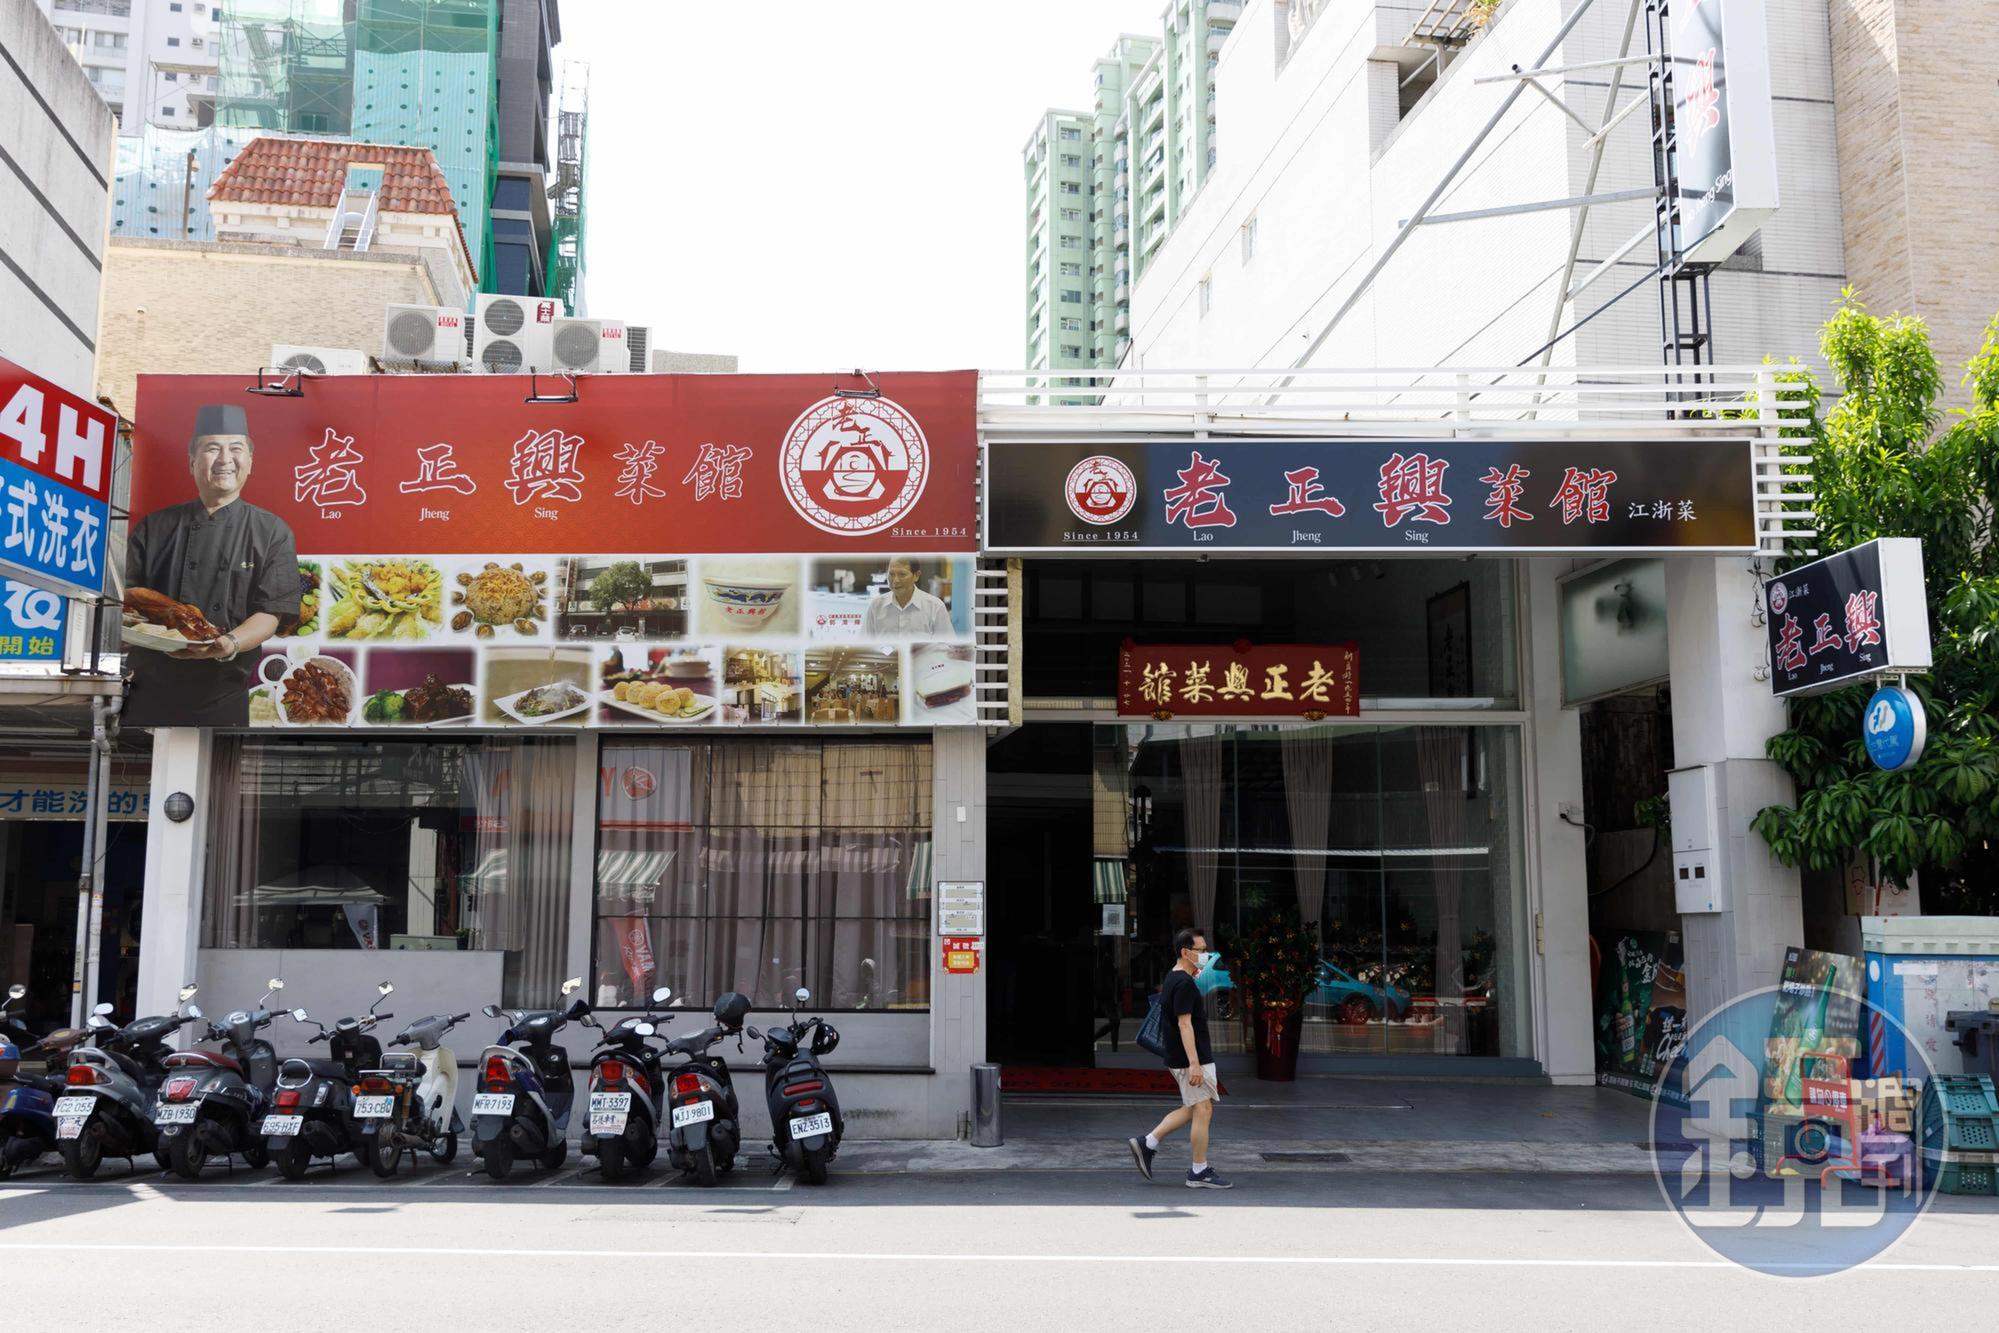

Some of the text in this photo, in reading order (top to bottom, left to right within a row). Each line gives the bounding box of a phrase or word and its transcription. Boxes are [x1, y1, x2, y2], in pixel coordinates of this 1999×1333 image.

[294, 427, 753, 506] 老正興菜館
[1163, 450, 1617, 529] 老正興菜館
[320, 507, 558, 521] Lao Jheng Sing
[1627, 499, 1698, 521] 江浙菜
[892, 527, 967, 536] Since 1954
[1063, 531, 1138, 540] Since 1954
[1193, 529, 1429, 543] Lao Jheng Sing
[1775, 589, 1881, 672] 老正興
